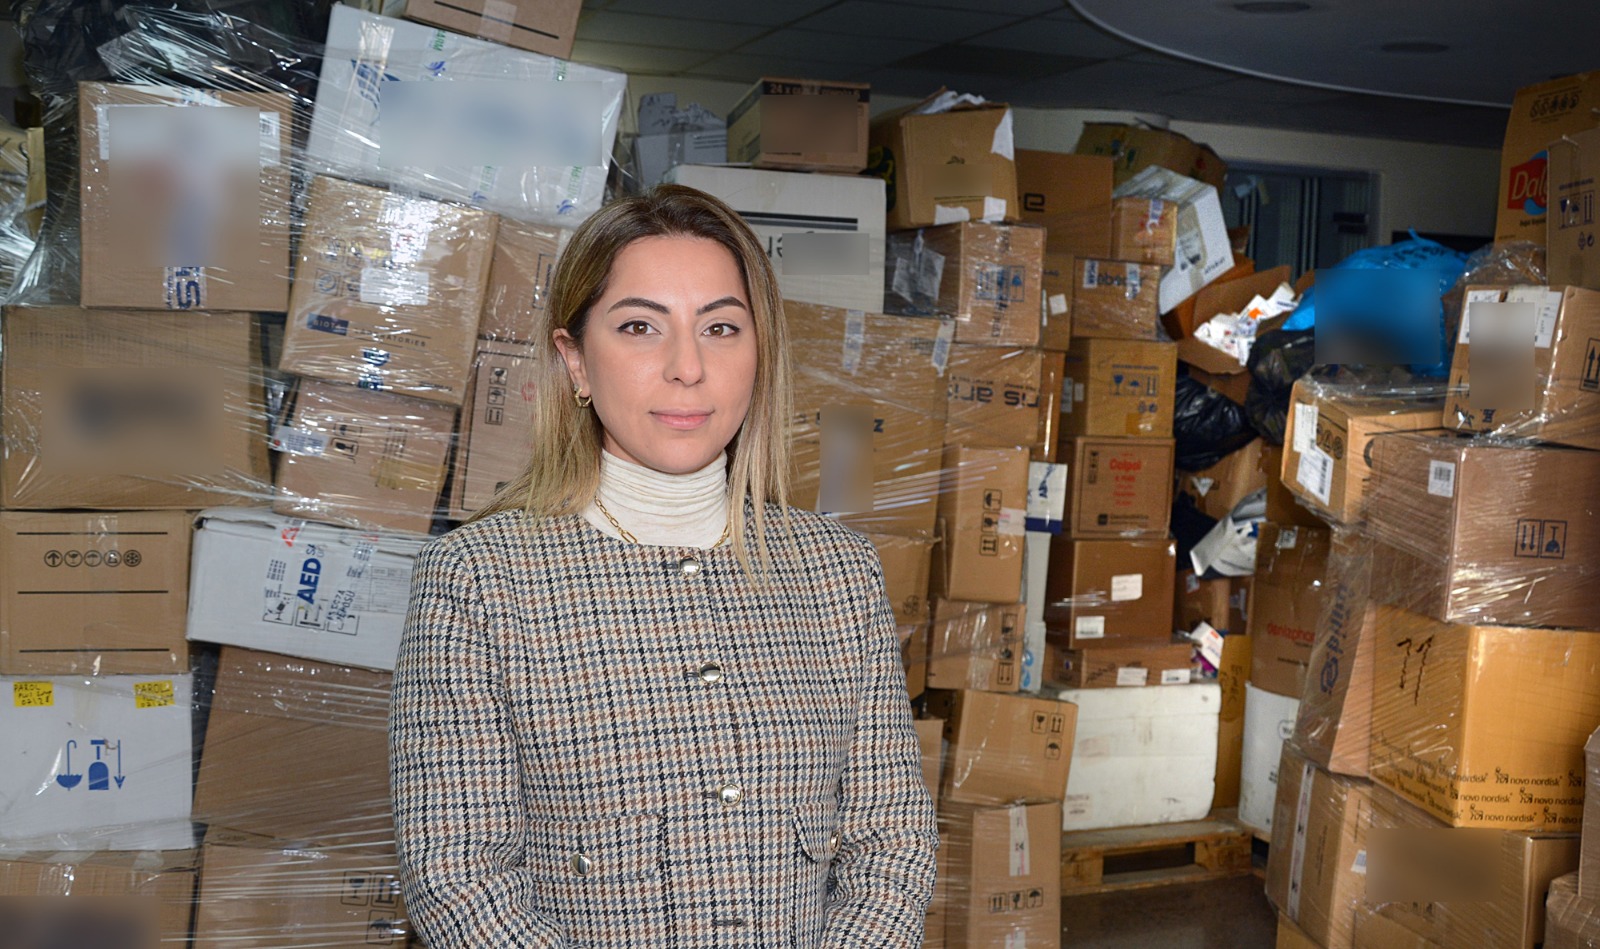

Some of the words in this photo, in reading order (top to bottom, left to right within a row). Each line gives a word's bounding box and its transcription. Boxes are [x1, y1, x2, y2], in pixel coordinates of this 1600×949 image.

[297, 558, 322, 605] AED
[1531, 777, 1560, 786] nordisk
[1460, 794, 1481, 802] novo
[1481, 794, 1510, 803] nordisk
[1534, 797, 1554, 805] novo
[1505, 813, 1535, 822] nordisk
